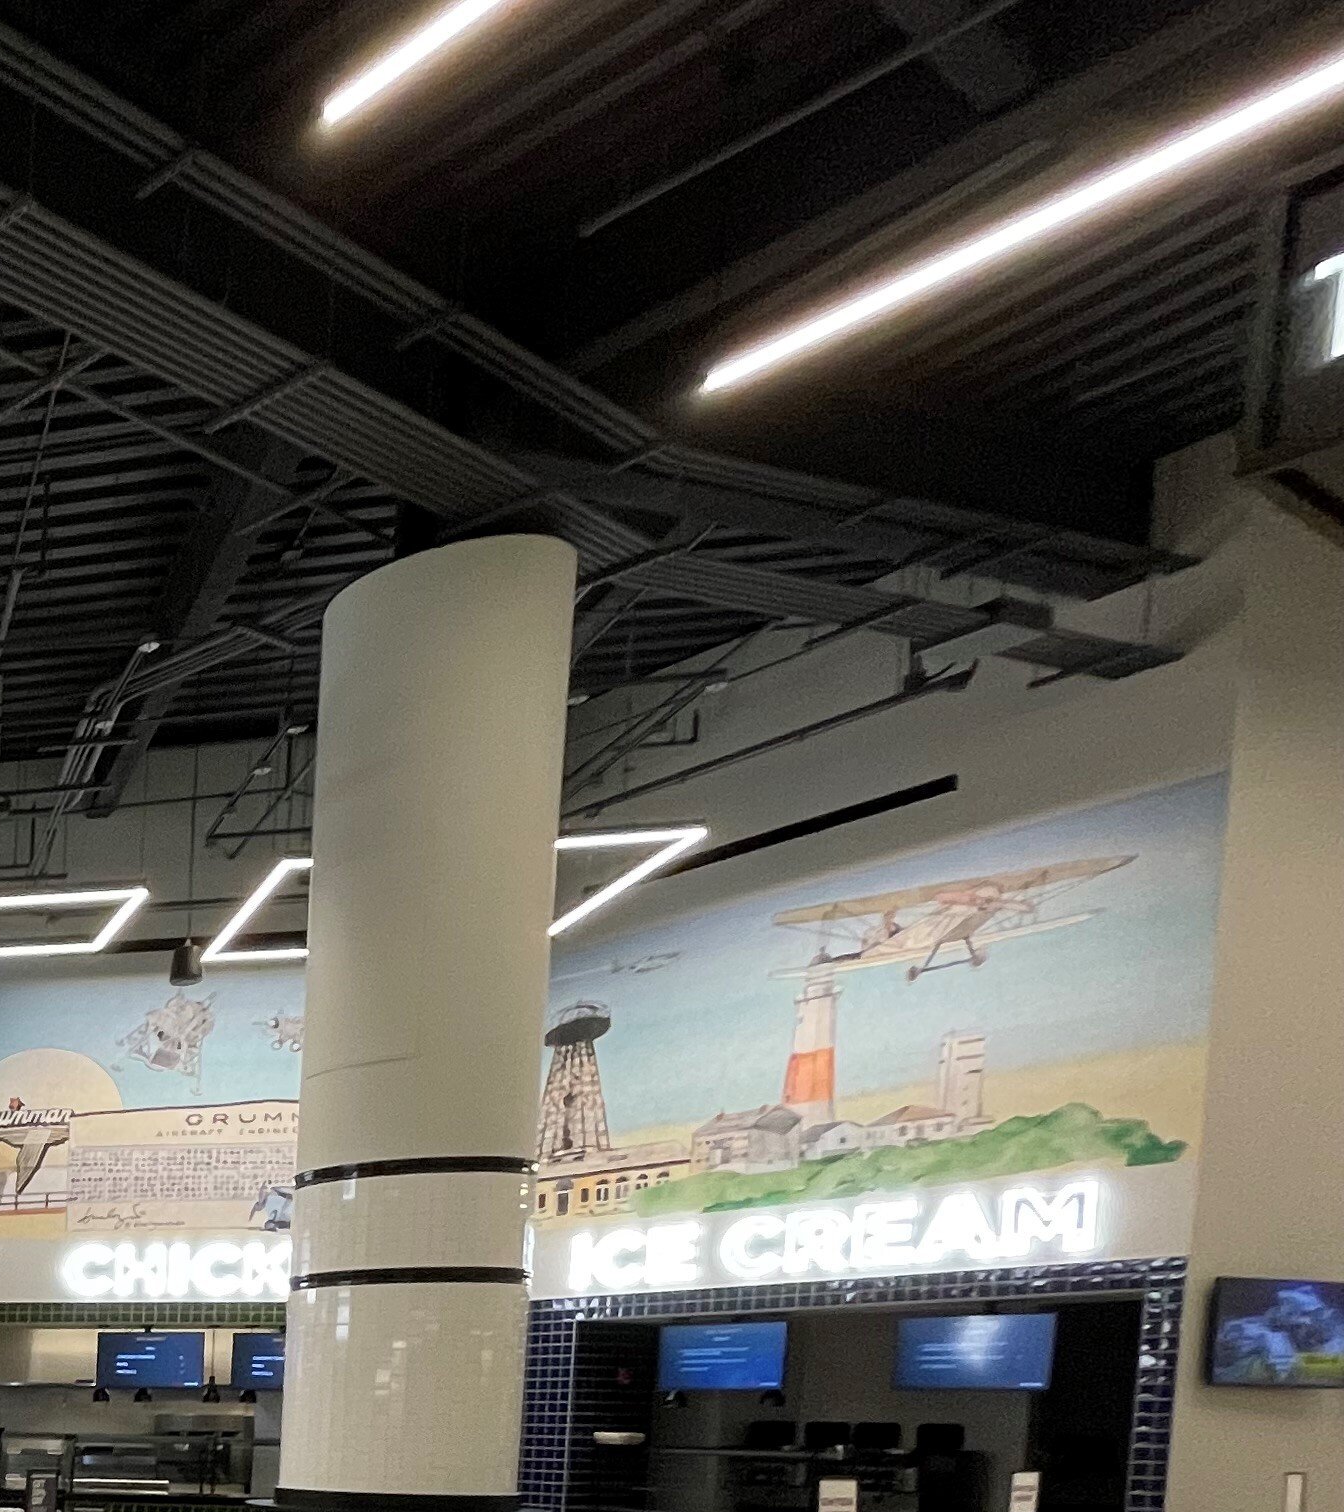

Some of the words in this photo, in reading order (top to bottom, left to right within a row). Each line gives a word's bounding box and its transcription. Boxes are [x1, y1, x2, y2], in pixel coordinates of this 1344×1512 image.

[185, 1111, 299, 1126] GRUM
[568, 1222, 703, 1292] ICE
[719, 1180, 1102, 1280] CREAM
[64, 1241, 294, 1296] CHICK
